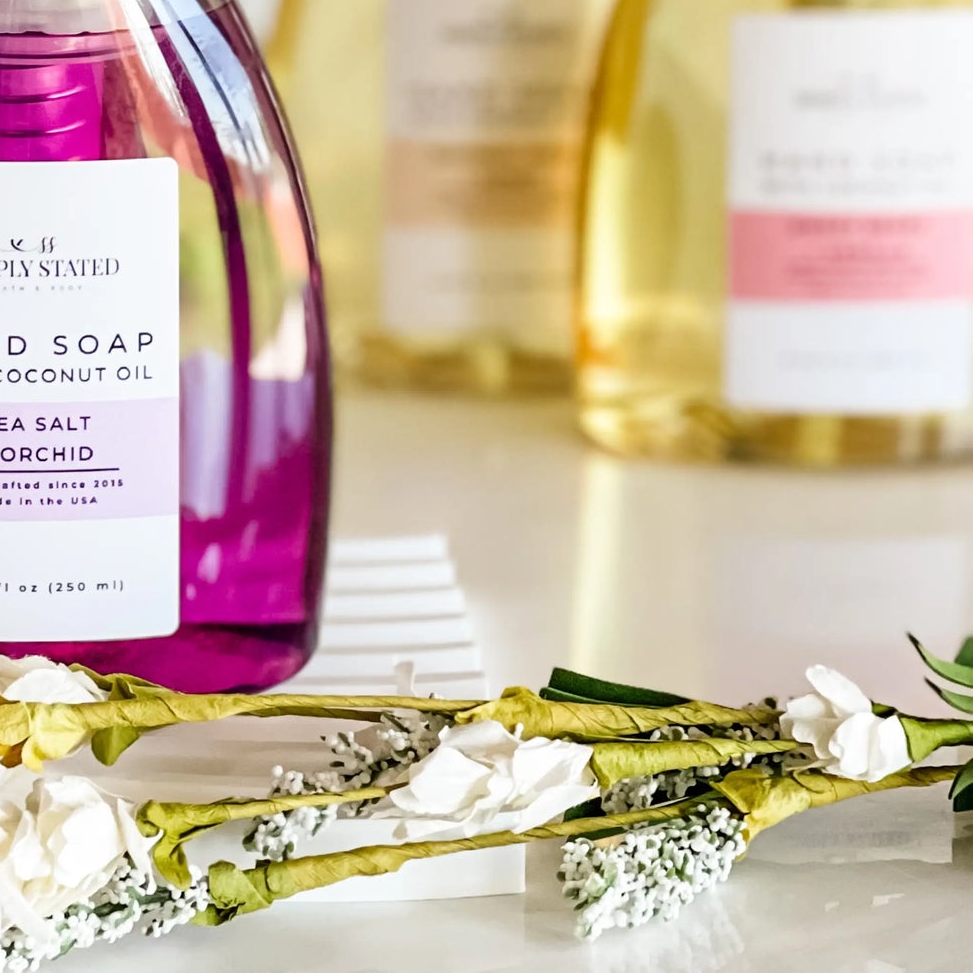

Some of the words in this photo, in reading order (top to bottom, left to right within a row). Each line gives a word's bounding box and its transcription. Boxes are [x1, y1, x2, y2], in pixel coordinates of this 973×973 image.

[39, 258, 120, 277] STATED
[53, 332, 154, 355] SOAP
[116, 365, 154, 381] OIL
[35, 416, 92, 432] SALT
[0, 446, 94, 462] ORCHID
[48, 480, 86, 489] since
[93, 479, 124, 488] 2015
[19, 497, 33, 506] in
[40, 497, 63, 506] the
[71, 496, 98, 505] USA
[19, 584, 38, 593] oz
[48, 582, 86, 594] (250
[96, 580, 124, 592] ml)
